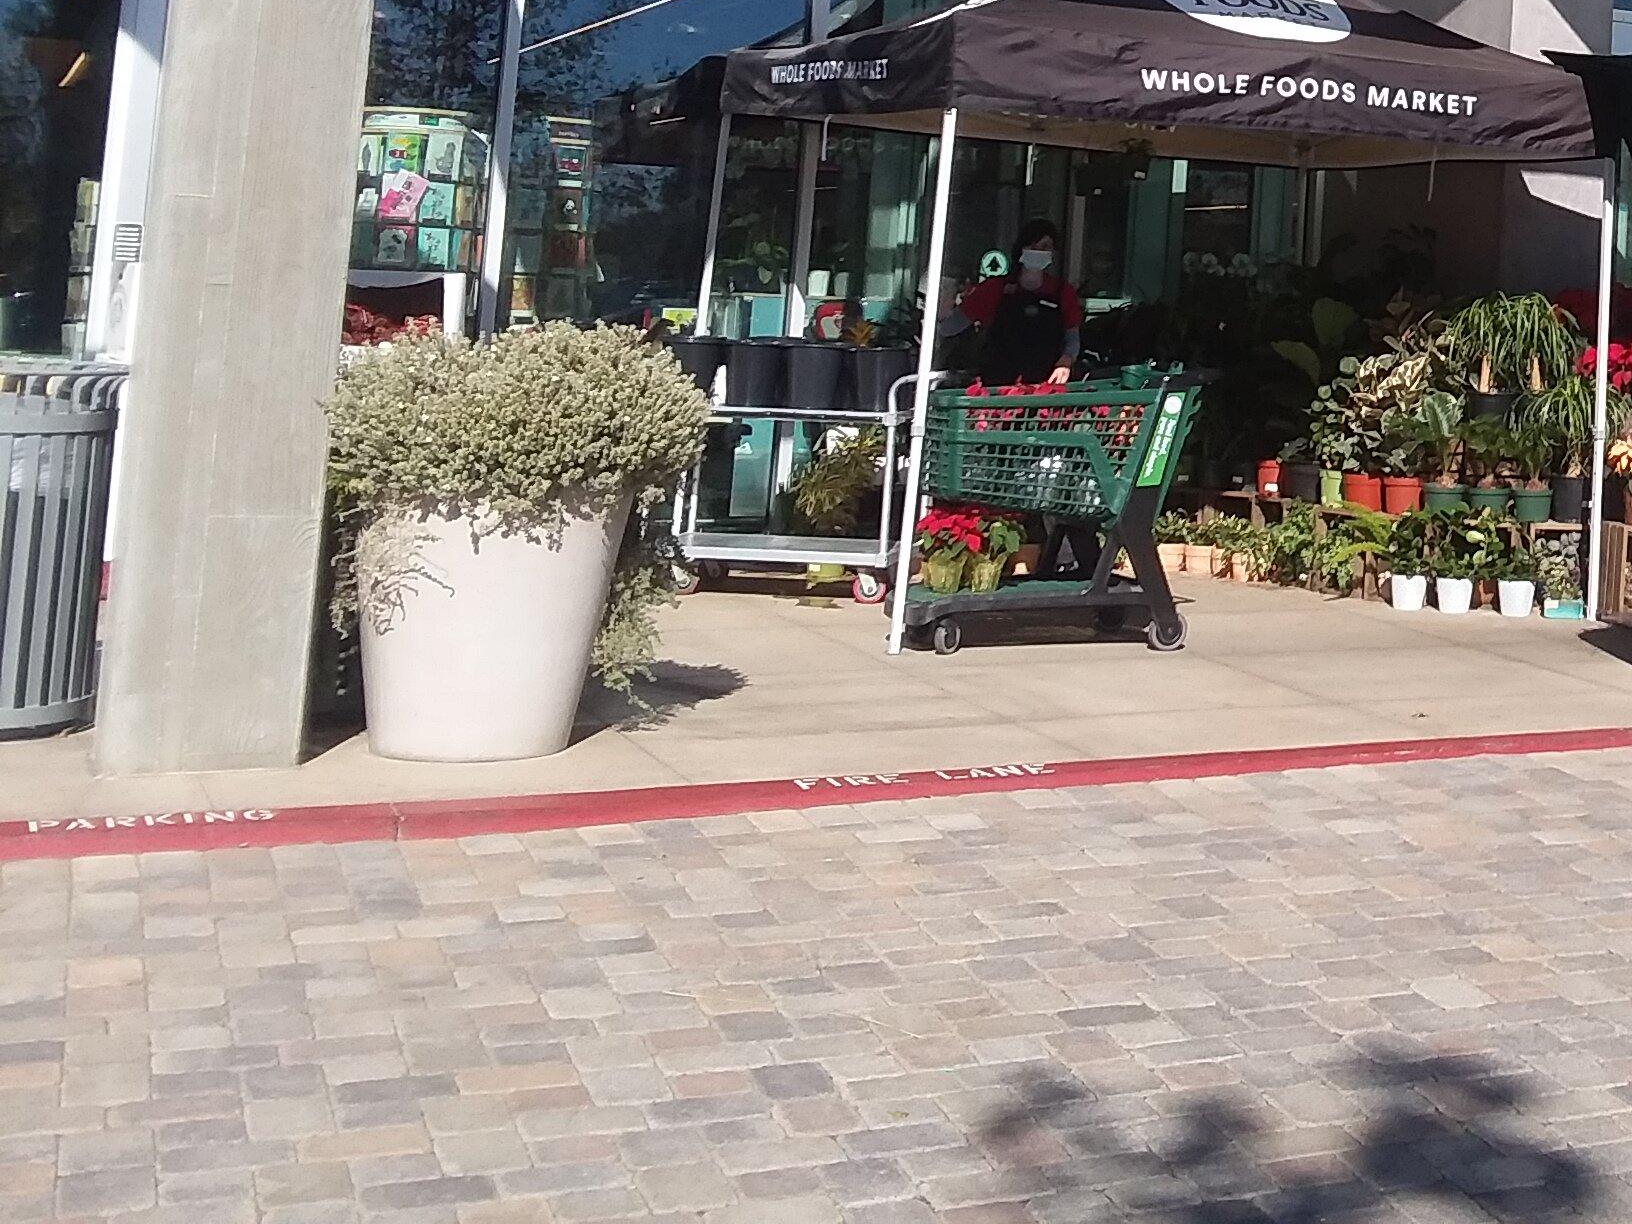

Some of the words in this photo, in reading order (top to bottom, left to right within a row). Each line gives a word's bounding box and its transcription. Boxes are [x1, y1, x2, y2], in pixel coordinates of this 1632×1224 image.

[771, 64, 806, 84] WHOLE
[844, 58, 889, 79] MARKET
[1140, 68, 1250, 95] WHOLE
[1260, 75, 1357, 103] FOODS
[1367, 85, 1479, 117] MARKET
[794, 772, 910, 791] FIRE
[934, 762, 1056, 781] LANE
[27, 808, 276, 833] PARKING
